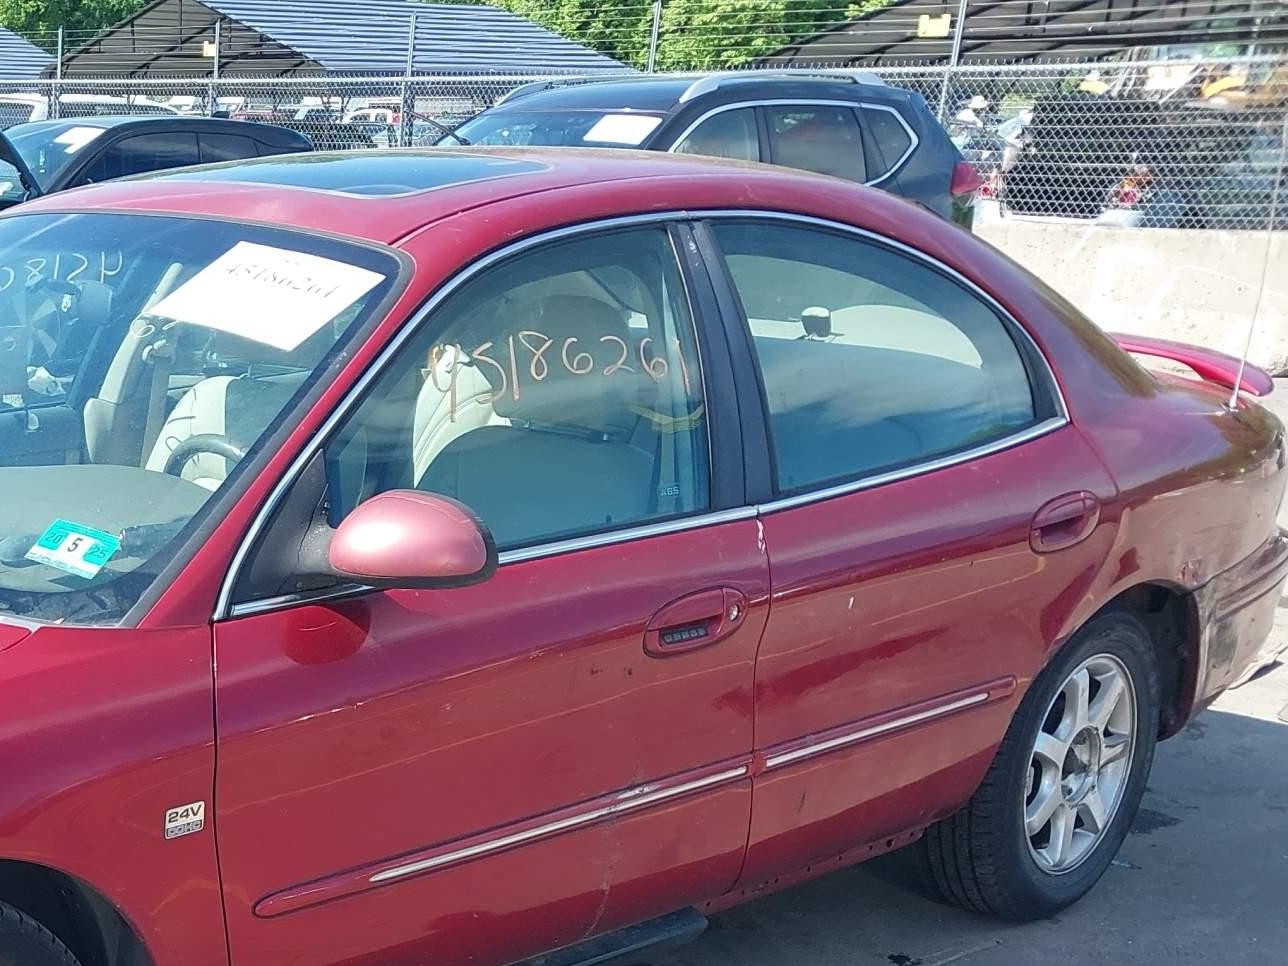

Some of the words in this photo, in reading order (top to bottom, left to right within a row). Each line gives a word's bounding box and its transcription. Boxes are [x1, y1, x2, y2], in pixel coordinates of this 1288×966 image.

[67, 537, 83, 552] 5
[87, 543, 109, 559] 25
[168, 804, 202, 824] 24V
